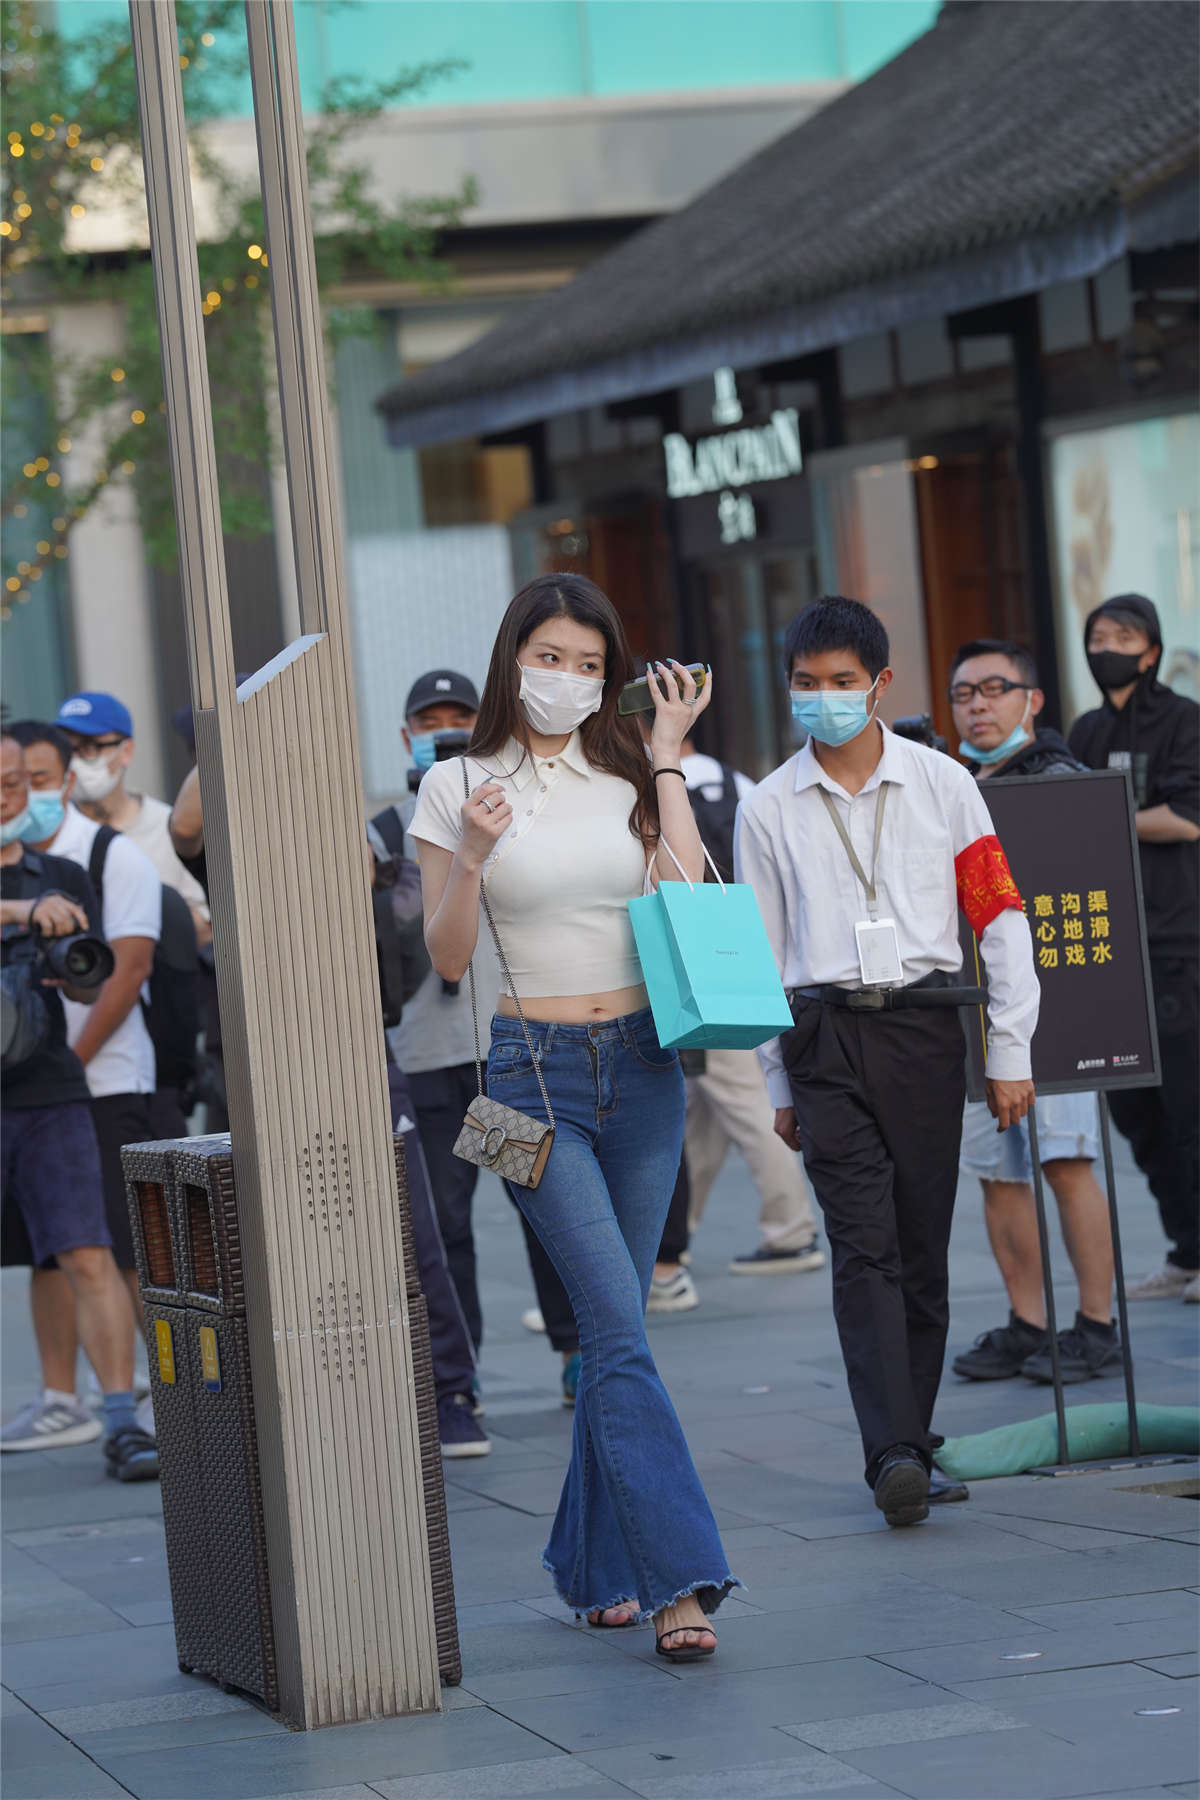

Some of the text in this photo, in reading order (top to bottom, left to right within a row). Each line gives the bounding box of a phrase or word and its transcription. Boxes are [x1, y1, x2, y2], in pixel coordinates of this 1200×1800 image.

[1022, 890, 1108, 917] 意沟渠
[1036, 916, 1110, 942] 心地滑
[1038, 941, 1112, 968] 勿戏水
